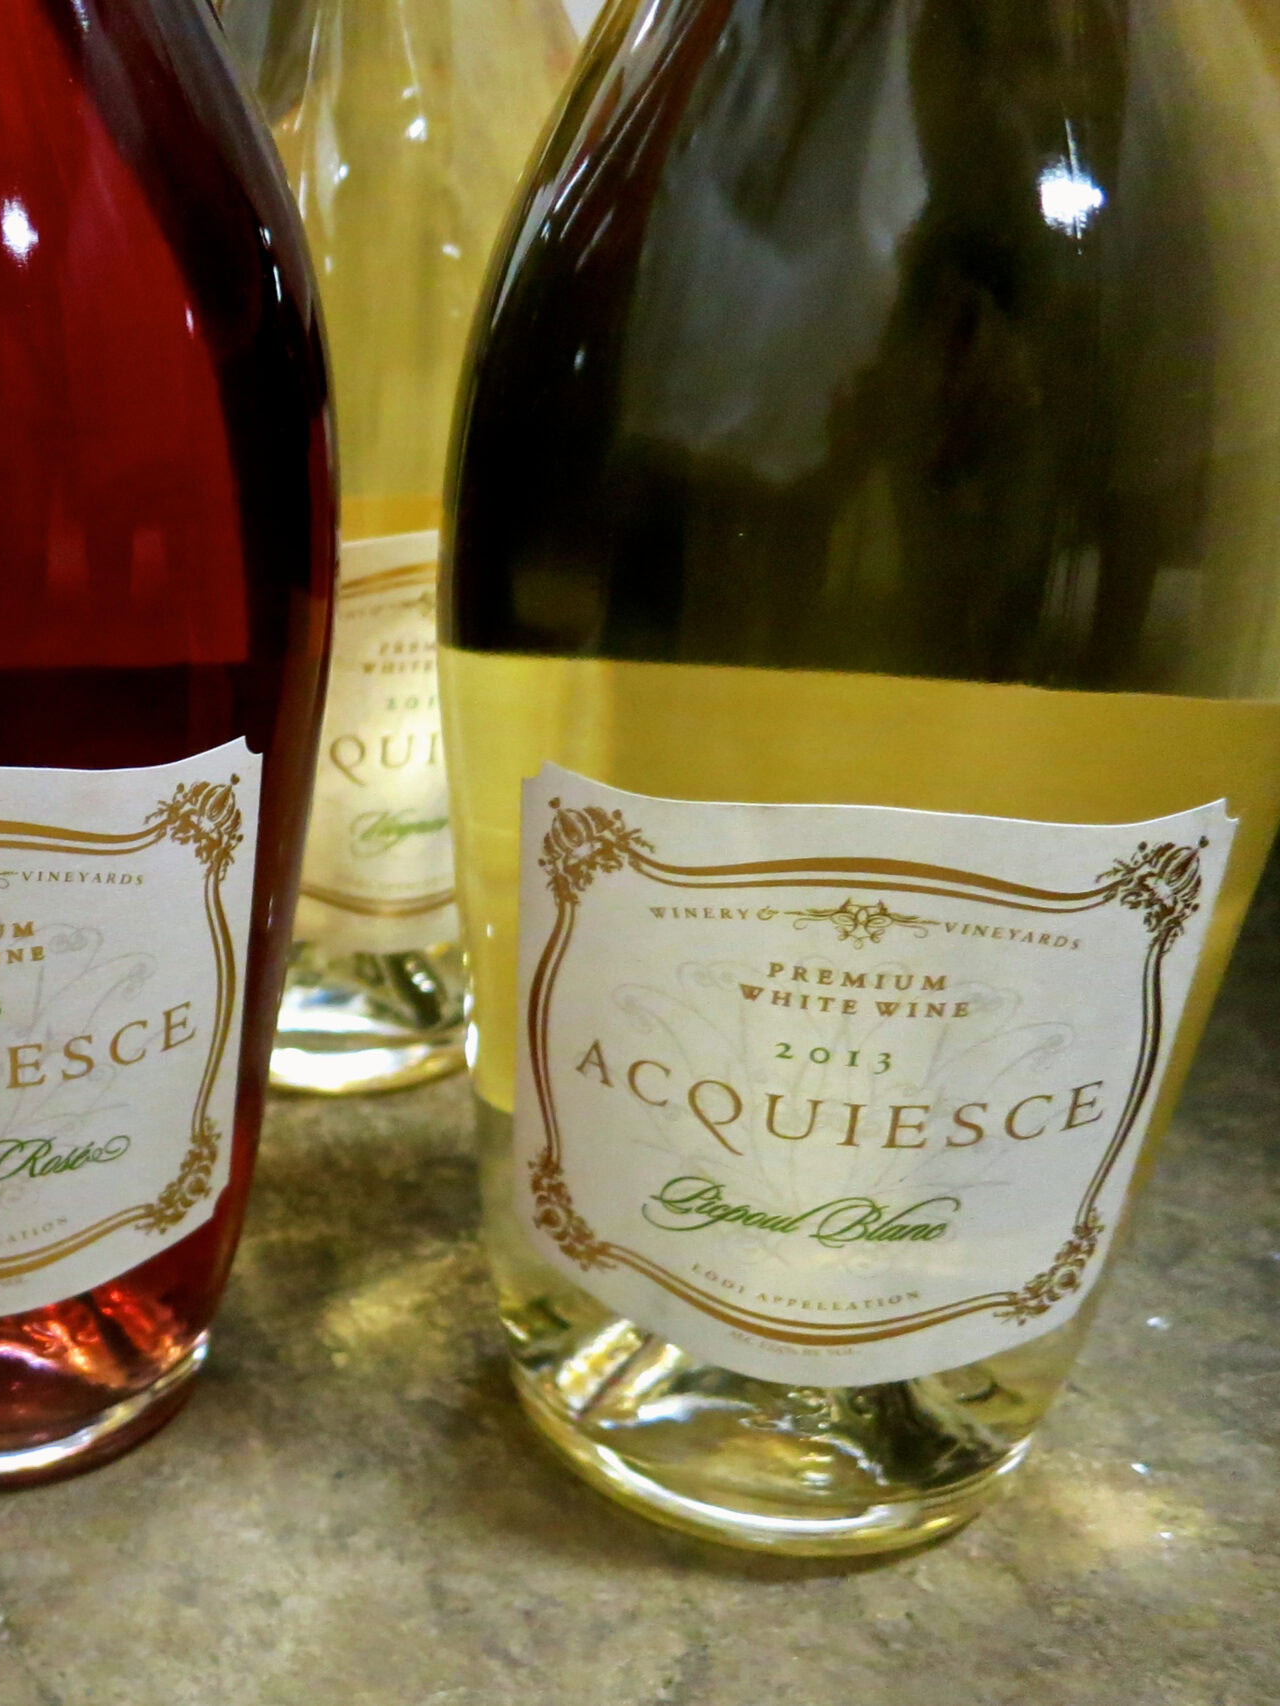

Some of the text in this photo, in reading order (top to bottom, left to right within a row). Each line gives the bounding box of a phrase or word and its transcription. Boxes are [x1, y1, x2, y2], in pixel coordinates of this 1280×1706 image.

[21, 870, 145, 887] VINEYARDS
[649, 905, 750, 921] WINERY
[944, 921, 1082, 952] VINEYARDS
[767, 961, 951, 992] PREMIUM
[738, 983, 972, 1019] WHITE WINE
[775, 1041, 895, 1075] 2013
[575, 1038, 1106, 1157] ACQUIESCE
[809, 1197, 961, 1249] Blanc
[757, 1289, 922, 1312] APPELLATION
